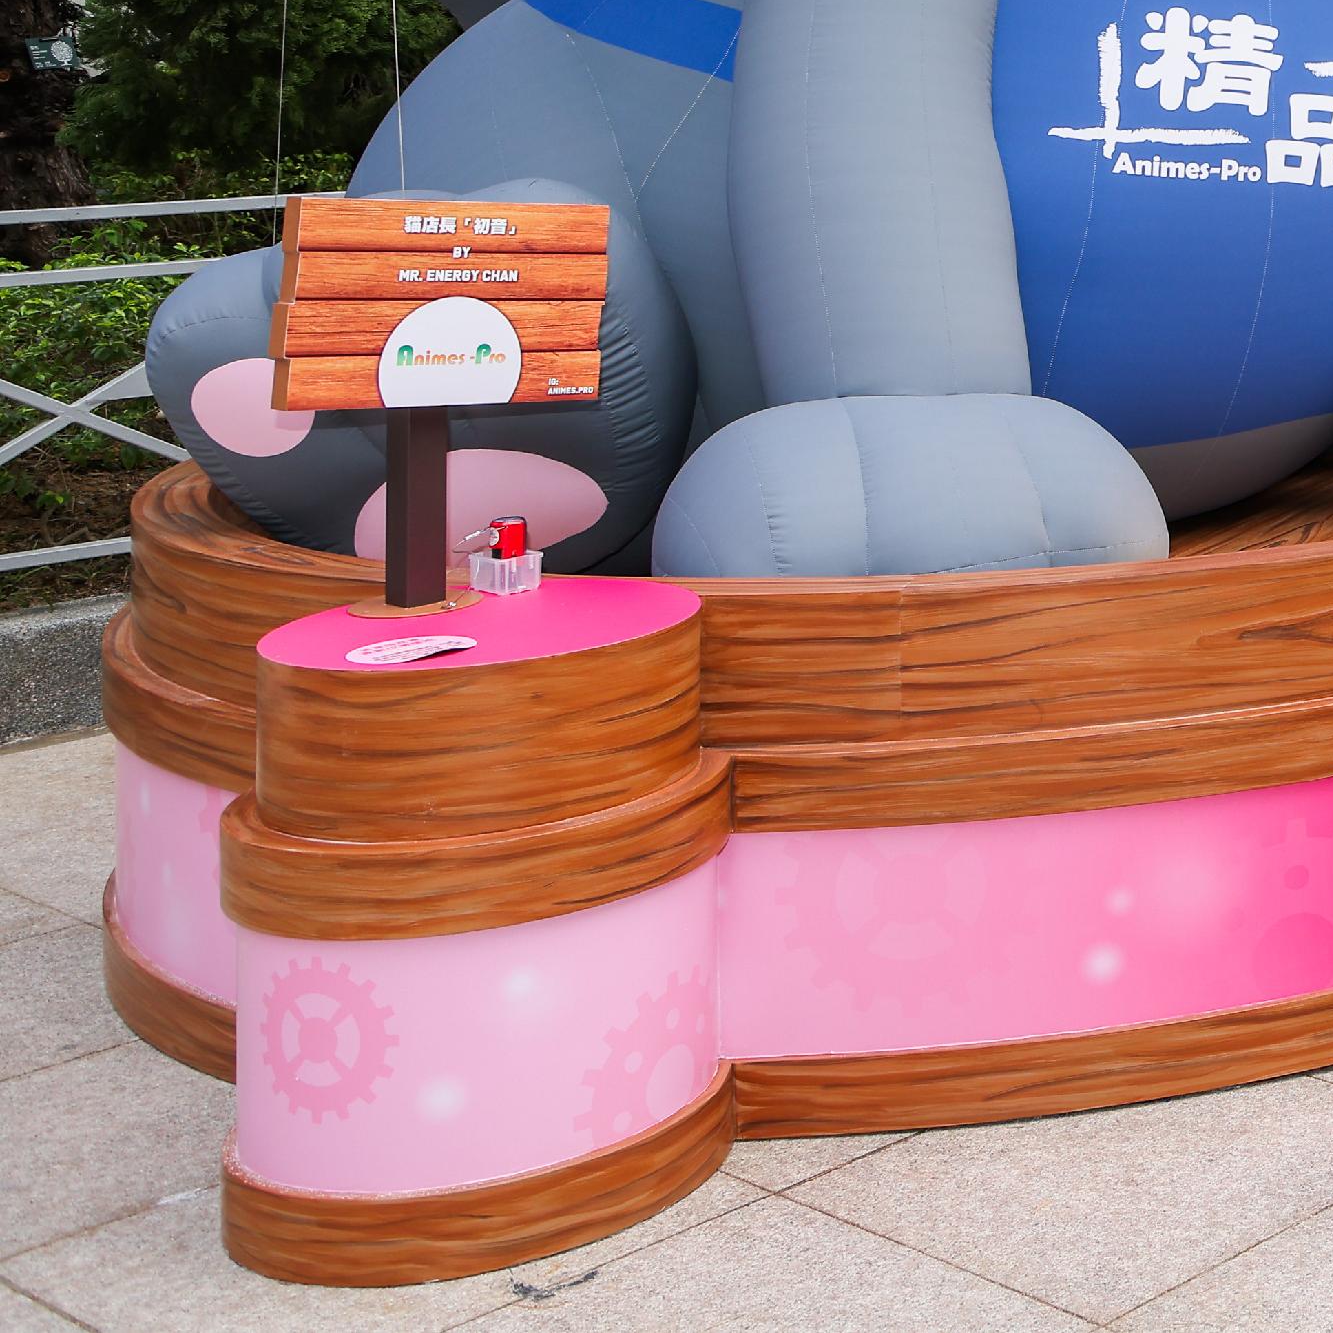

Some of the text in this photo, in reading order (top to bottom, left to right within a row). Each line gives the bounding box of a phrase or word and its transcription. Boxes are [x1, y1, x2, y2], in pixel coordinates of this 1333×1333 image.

[1112, 152, 1262, 182] Animes-Pro
[403, 216, 517, 235] 貓店長「初音」
[453, 247, 471, 258] BY
[399, 270, 518, 282] MR. ENERGY CHAN
[548, 377, 559, 386] IG:
